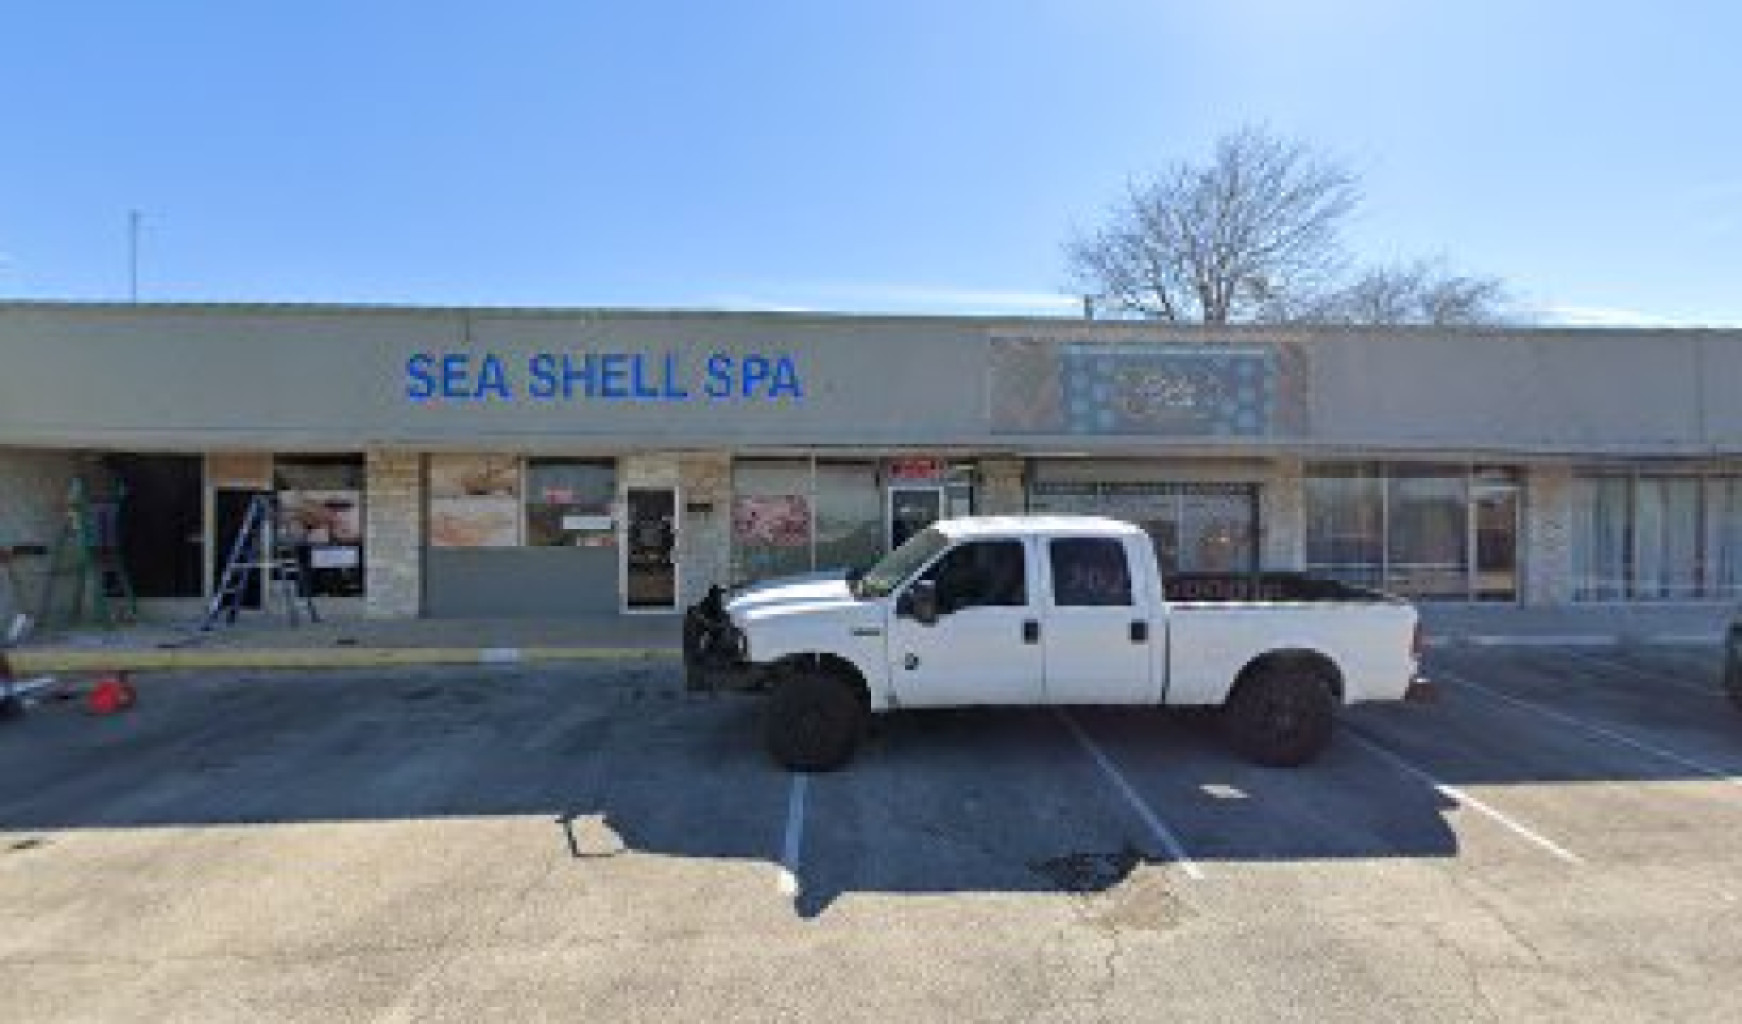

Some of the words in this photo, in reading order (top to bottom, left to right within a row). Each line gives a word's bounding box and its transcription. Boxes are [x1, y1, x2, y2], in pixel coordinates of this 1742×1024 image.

[405, 353, 511, 400] SEA
[527, 353, 688, 400] SHELL
[705, 353, 802, 400] SPA
